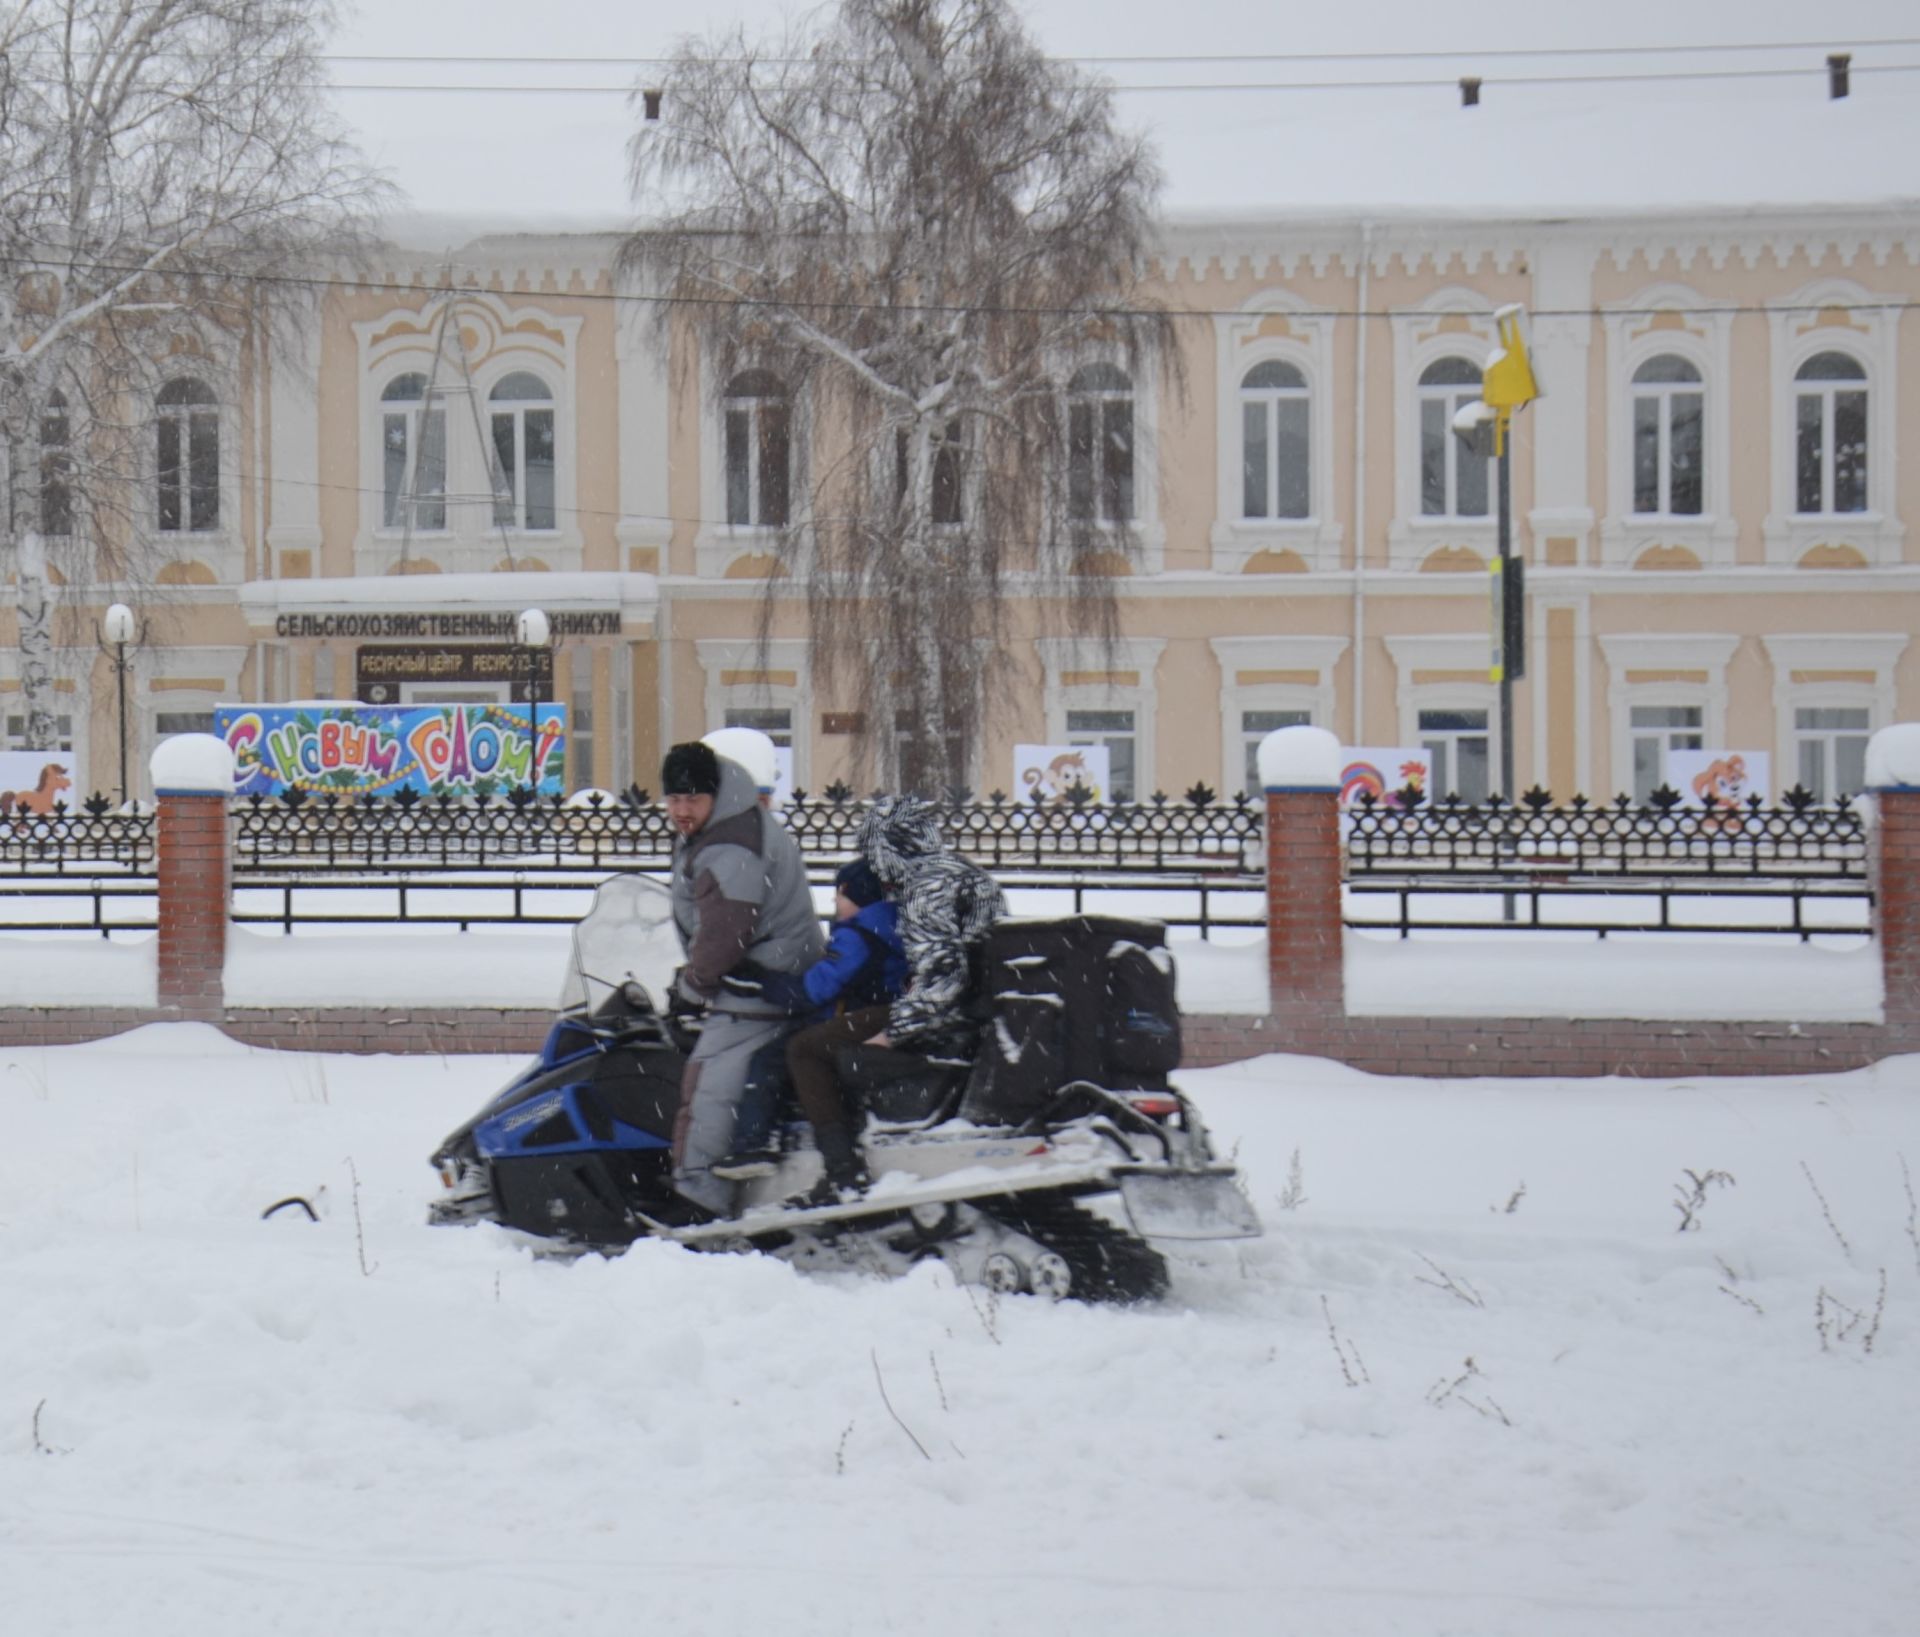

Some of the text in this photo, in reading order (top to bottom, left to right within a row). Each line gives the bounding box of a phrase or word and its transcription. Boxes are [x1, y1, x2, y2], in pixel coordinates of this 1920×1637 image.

[276, 611, 622, 637] СЕЛЬСКОХОЗЯЙСТВЕННЫЙ ХНИКУМ
[360, 651, 463, 675] РЕСУРСНЫЙ ЦЕНТР
[226, 713, 262, 785] С
